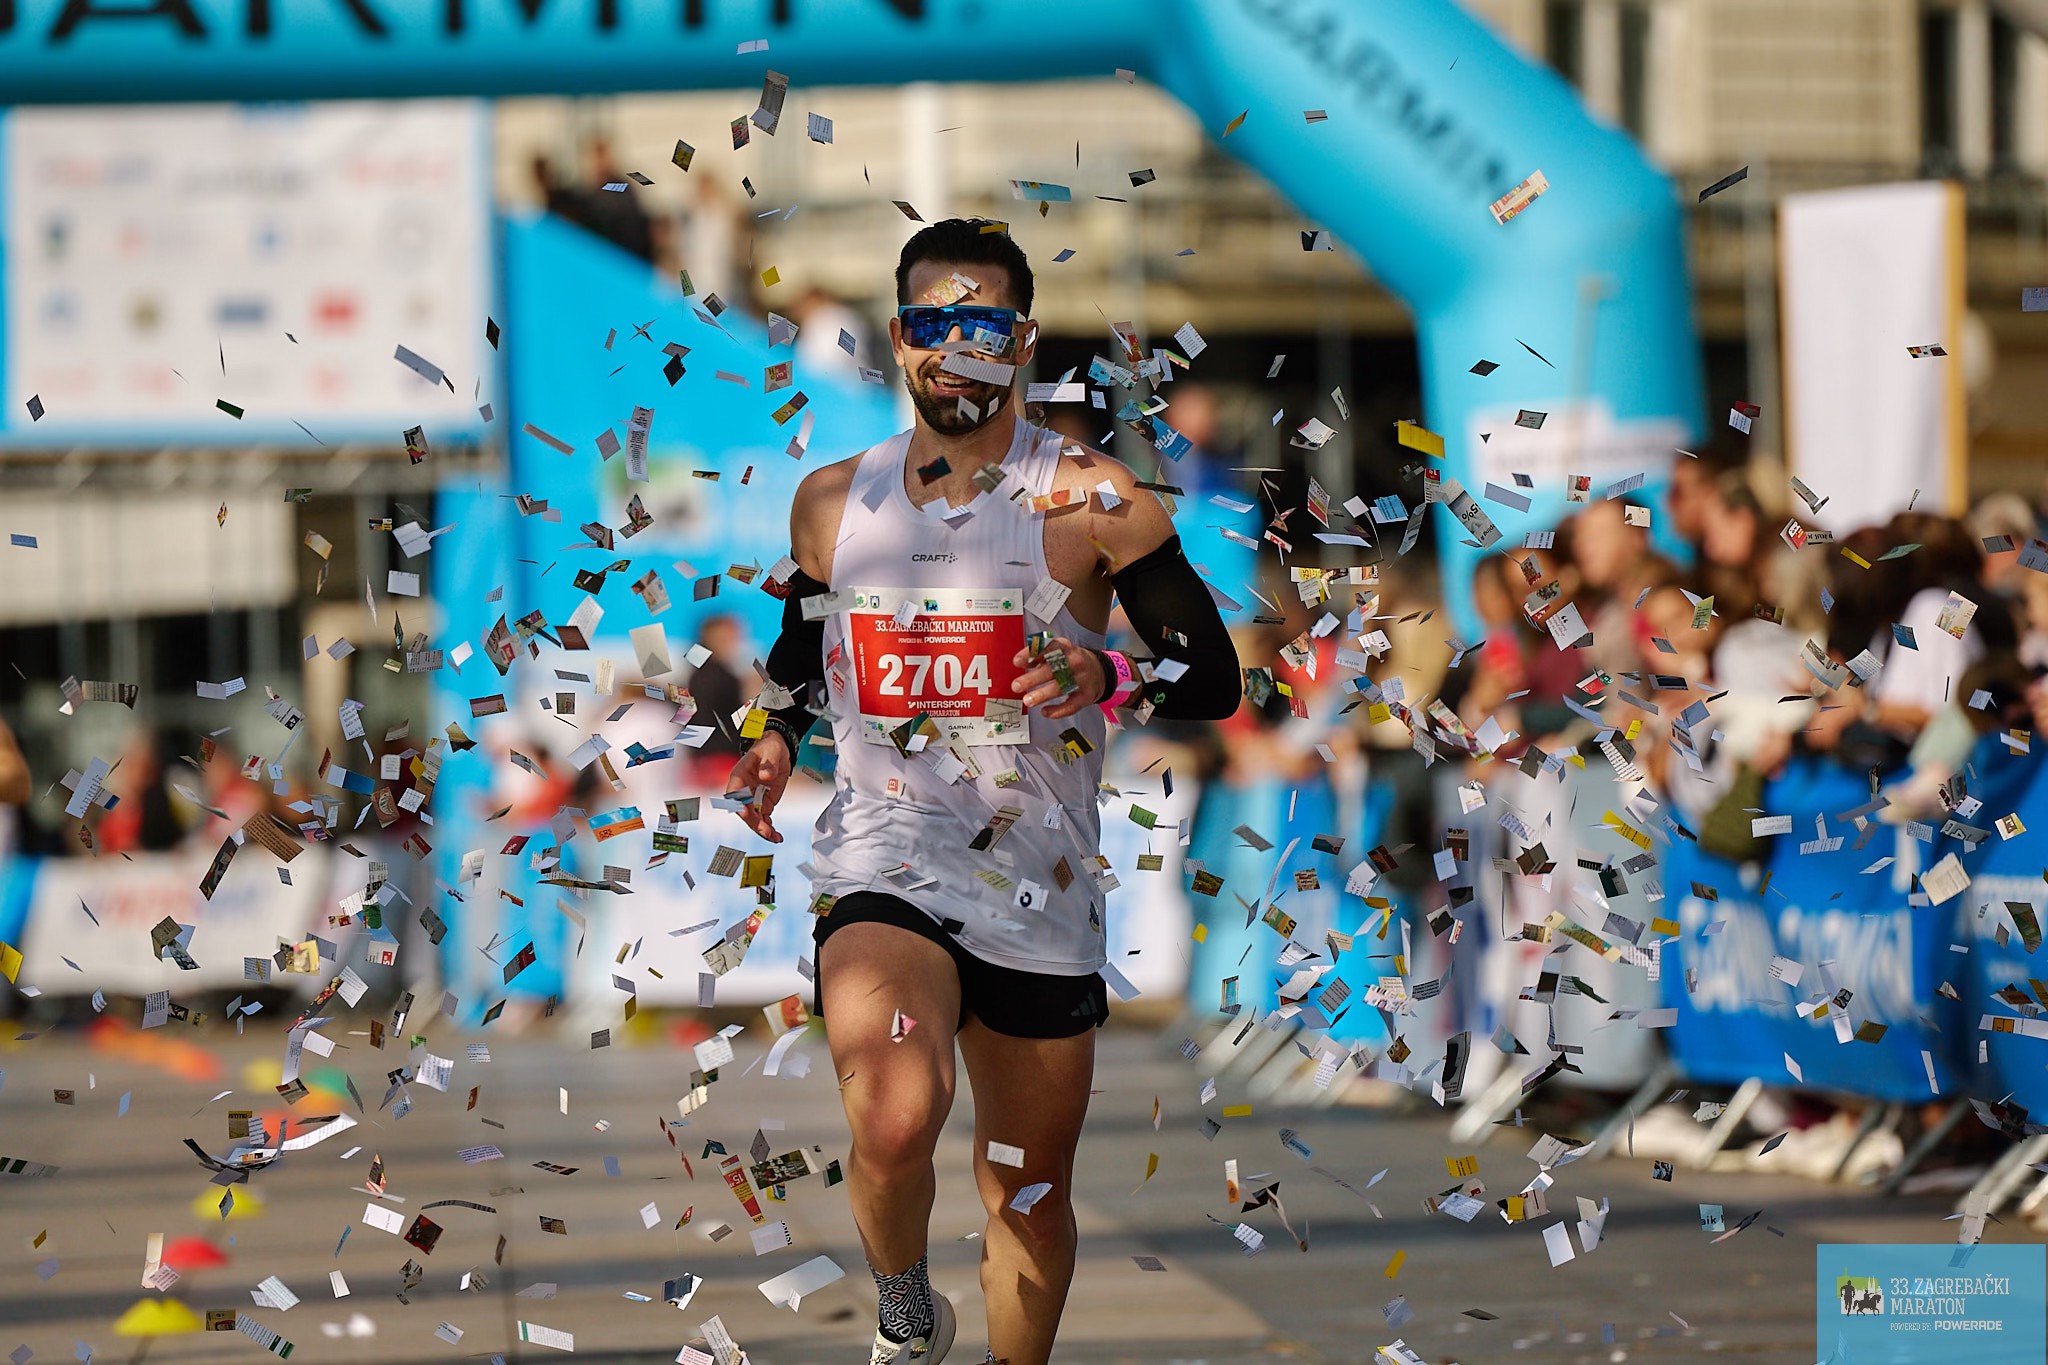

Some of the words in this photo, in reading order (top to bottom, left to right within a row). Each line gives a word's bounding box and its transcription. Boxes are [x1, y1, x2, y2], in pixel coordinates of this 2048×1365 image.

[911, 554, 948, 562] CRAFT
[948, 620, 995, 633] MARATON
[924, 636, 967, 644] POWERADE
[878, 653, 992, 696] 2704
[916, 700, 972, 709] INTERSPORT
